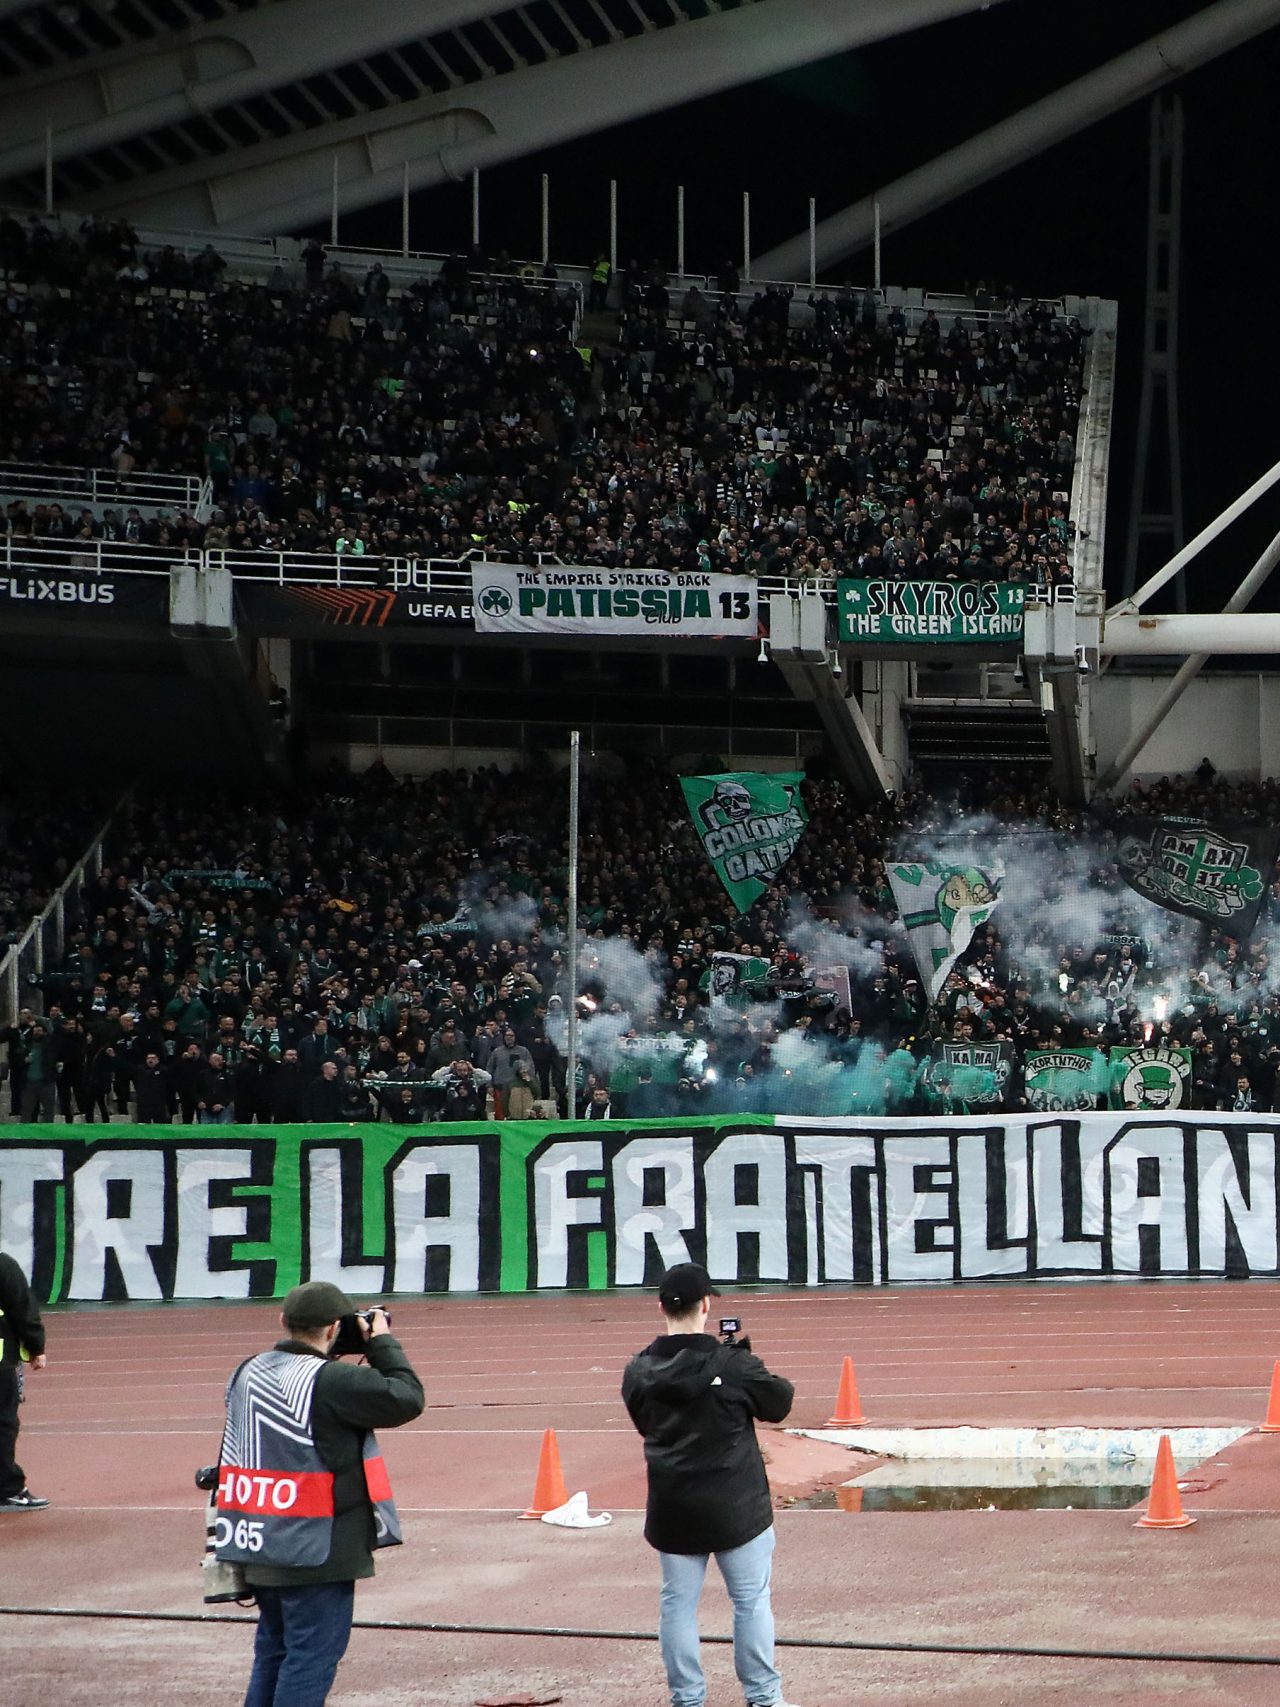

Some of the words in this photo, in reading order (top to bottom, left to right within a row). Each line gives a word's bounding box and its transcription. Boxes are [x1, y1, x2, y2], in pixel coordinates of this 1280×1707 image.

[516, 573, 539, 585] THE
[546, 573, 602, 586] EMPIRE
[677, 575, 711, 587] BACK
[518, 588, 712, 619] PATISSIA
[718, 592, 750, 620] 13
[866, 581, 999, 619] SKYROS
[1007, 589, 1024, 604] 13
[408, 603, 457, 619] UEFA
[644, 609, 682, 625] Club
[846, 613, 881, 635] THE
[891, 613, 951, 636] GREEN
[962, 613, 1024, 636] ISLAND
[953, 1051, 969, 1064] KA
[975, 1051, 993, 1065] MA
[300, 1136, 500, 1294] LA
